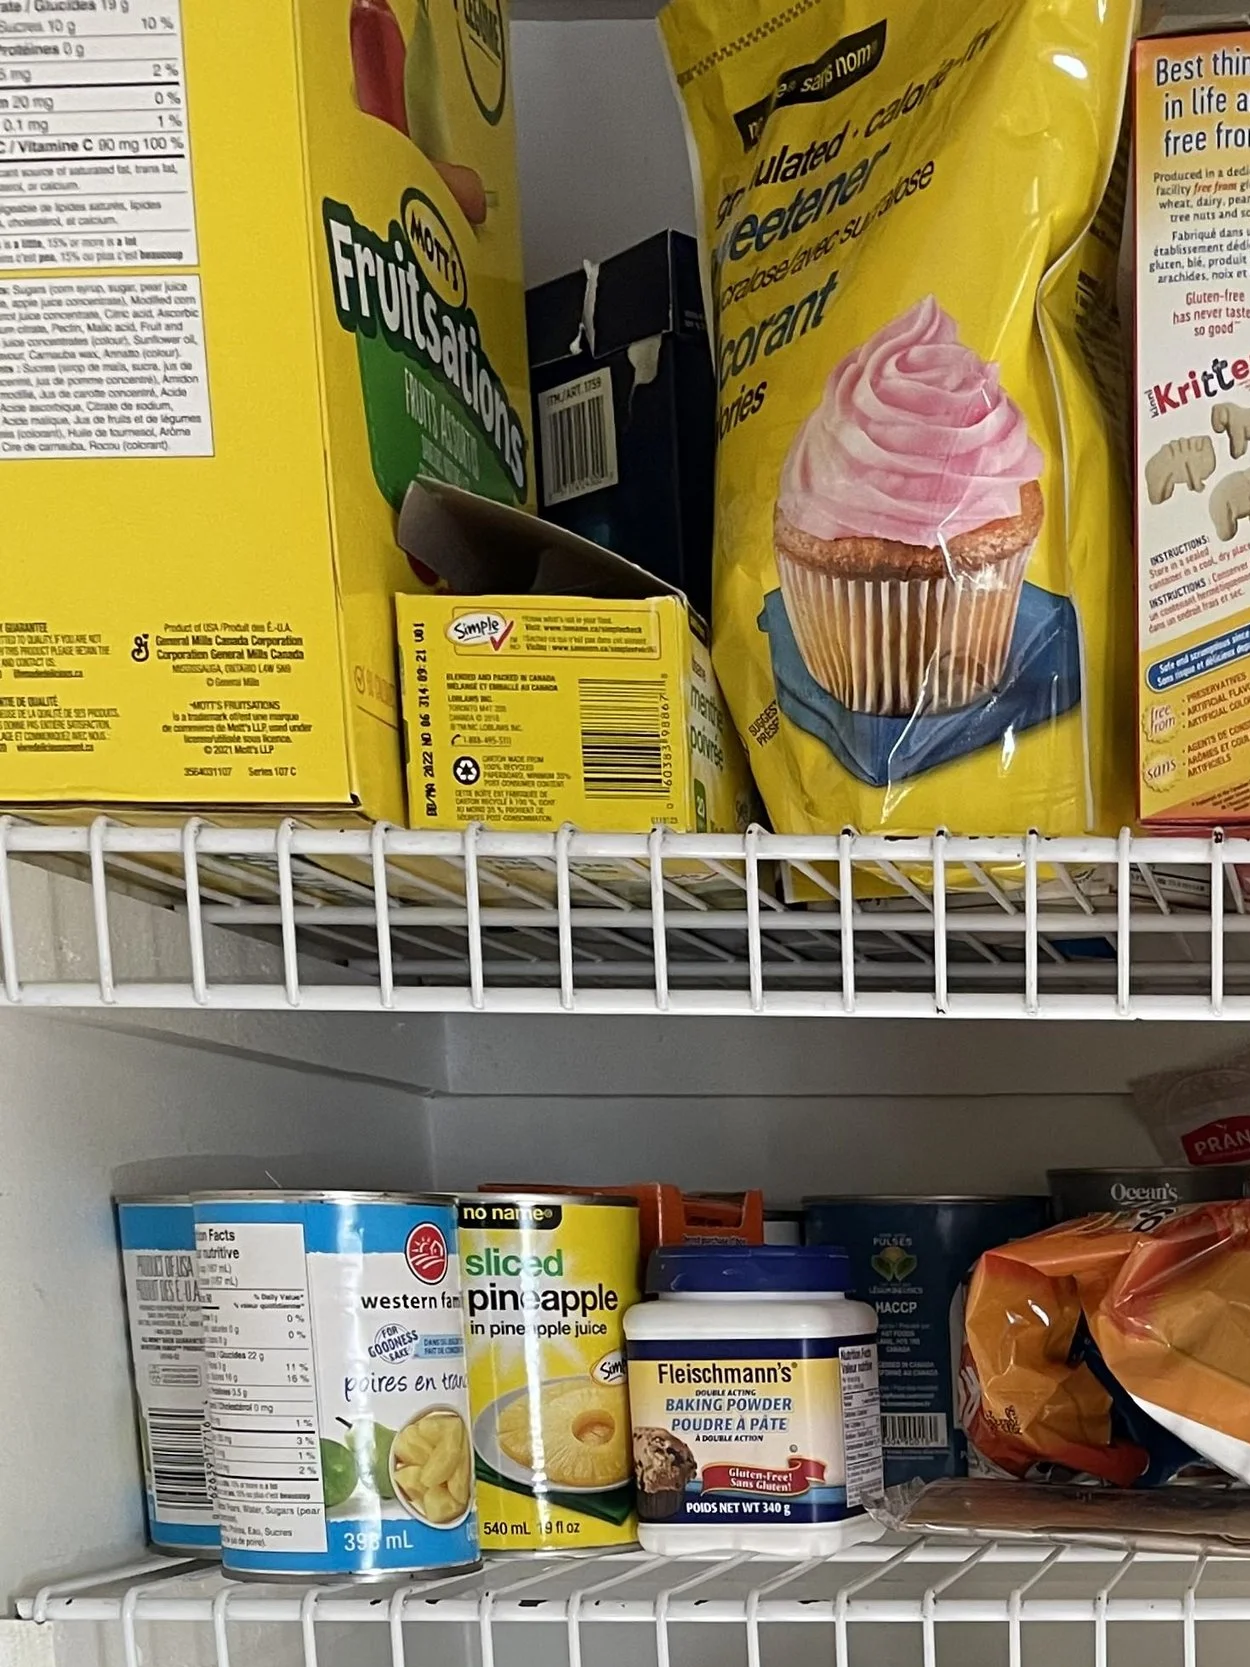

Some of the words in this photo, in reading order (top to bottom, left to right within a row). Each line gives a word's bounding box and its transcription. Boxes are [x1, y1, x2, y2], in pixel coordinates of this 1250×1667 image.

[836, 45, 872, 78] nom
[1156, 57, 1203, 87] Best
[1164, 93, 1183, 121] in
[1192, 86, 1227, 116] life
[20, 136, 79, 152] Vitamine
[83, 138, 93, 150] C
[119, 138, 139, 153] mg
[143, 137, 167, 149] 100
[170, 137, 184, 149] %
[1164, 127, 1207, 158] free
[1156, 184, 1191, 196] facility
[1193, 182, 1212, 196] free
[1213, 181, 1237, 194] from
[1159, 198, 1193, 209] wheat,
[1197, 196, 1226, 209] dairy,
[1186, 289, 1245, 306] Gluten-free
[1173, 312, 1191, 325] has
[1194, 308, 1222, 320] never
[1194, 326, 1205, 337] so
[1208, 322, 1234, 338] good
[330, 218, 524, 488] Fruitsations
[455, 617, 498, 641] Simple
[156, 636, 188, 646] General
[192, 636, 212, 646] Mills
[215, 636, 249, 647] Canada
[252, 636, 303, 646] Corporation
[157, 649, 208, 661] Corporation
[211, 649, 246, 660] General
[248, 649, 268, 660] Mills
[271, 649, 304, 660] Canada
[1187, 672, 1247, 702] PRESERVATIVES
[1187, 694, 1227, 716] ARTIFICIAL
[1188, 708, 1228, 728] ARTIFICIAL
[1110, 1183, 1178, 1201] Ocean's
[463, 1206, 486, 1221] no
[489, 1206, 544, 1221] name
[208, 1229, 236, 1243] Facts
[465, 1249, 564, 1278] sliced
[361, 1293, 438, 1310] western
[468, 1284, 619, 1317] pineapple
[875, 1302, 917, 1314] HACCP
[470, 1321, 486, 1336] in
[490, 1321, 570, 1338] pinepple
[574, 1320, 608, 1336] juice
[368, 1328, 419, 1358] GOODNESS
[658, 1362, 792, 1384] Fleischmann's
[666, 1398, 722, 1411] BAKING
[727, 1398, 792, 1411] POWDER
[672, 1418, 732, 1431] POUDRE
[736, 1415, 745, 1431] À
[750, 1414, 788, 1430] PÂTE
[729, 1468, 793, 1481] Gluten-Free!
[730, 1479, 753, 1489] Sans
[756, 1480, 792, 1492] Gluten!
[686, 1502, 717, 1513] POIDS
[719, 1502, 740, 1513] NET
[742, 1502, 759, 1513] WT
[762, 1502, 781, 1513] 340
[783, 1504, 790, 1516] g
[386, 1533, 414, 1549] mL
